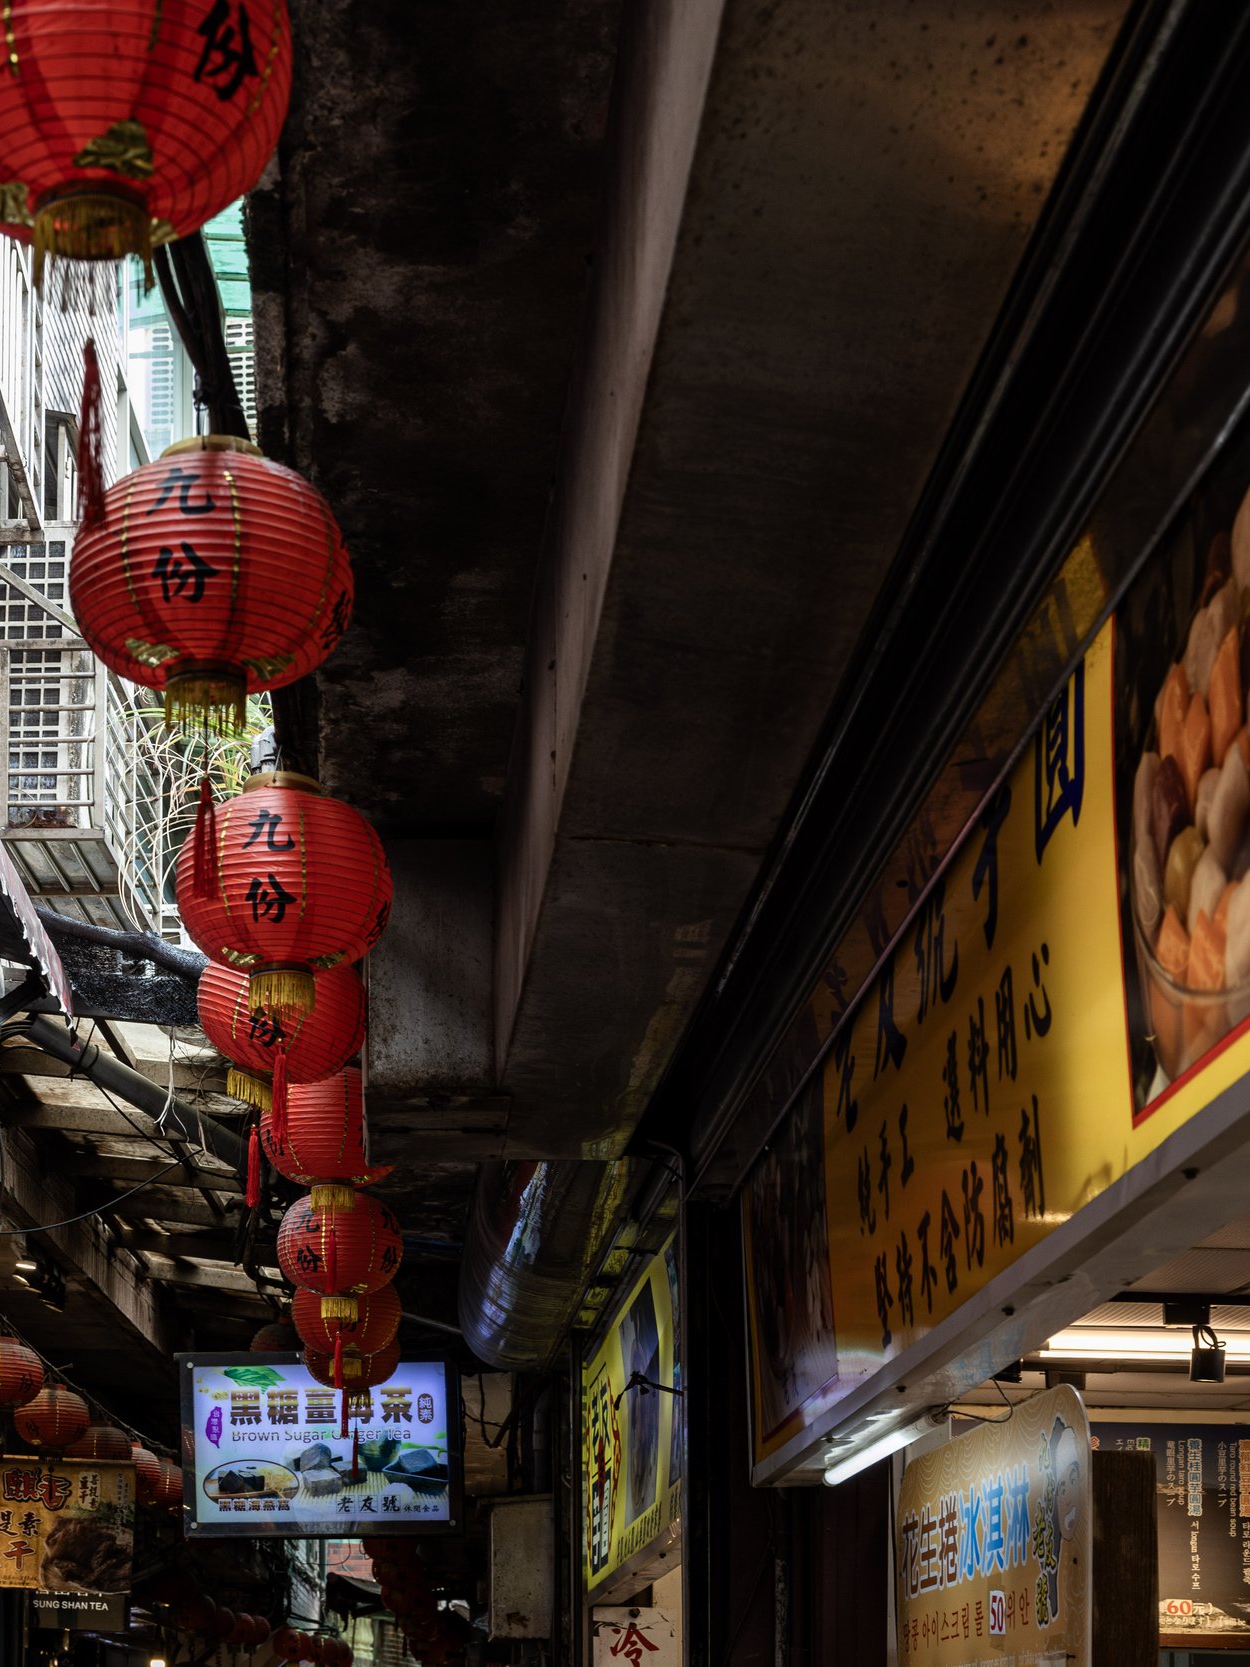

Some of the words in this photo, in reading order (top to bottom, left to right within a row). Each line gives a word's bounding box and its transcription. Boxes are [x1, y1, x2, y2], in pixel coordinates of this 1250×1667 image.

[146, 468, 220, 604] 九份
[242, 810, 298, 923] 九份
[943, 942, 1052, 1142] 選料用心
[296, 1209, 321, 1273] 九份
[419, 1396, 433, 1421] 純素
[232, 1430, 280, 1442] Brown
[284, 1429, 326, 1444] Sugar
[331, 1428, 381, 1444] Gnger
[1177, 1440, 1185, 1466] Longan
[1229, 1460, 1237, 1482] round
[1229, 1483, 1237, 1496] red
[337, 1495, 401, 1513] 老友號
[1229, 1497, 1237, 1517] bean
[903, 1462, 1029, 1599] 花生捲冰淇淋
[1229, 1518, 1237, 1538] soup
[33, 1599, 60, 1609] SUNG
[61, 1600, 88, 1610] SHAN
[90, 1602, 109, 1611] TEA
[922, 1603, 969, 1649] 아이스크림
[991, 1596, 1004, 1632] 50
[1007, 1588, 1030, 1632] 위안
[610, 1623, 660, 1667] 冷
